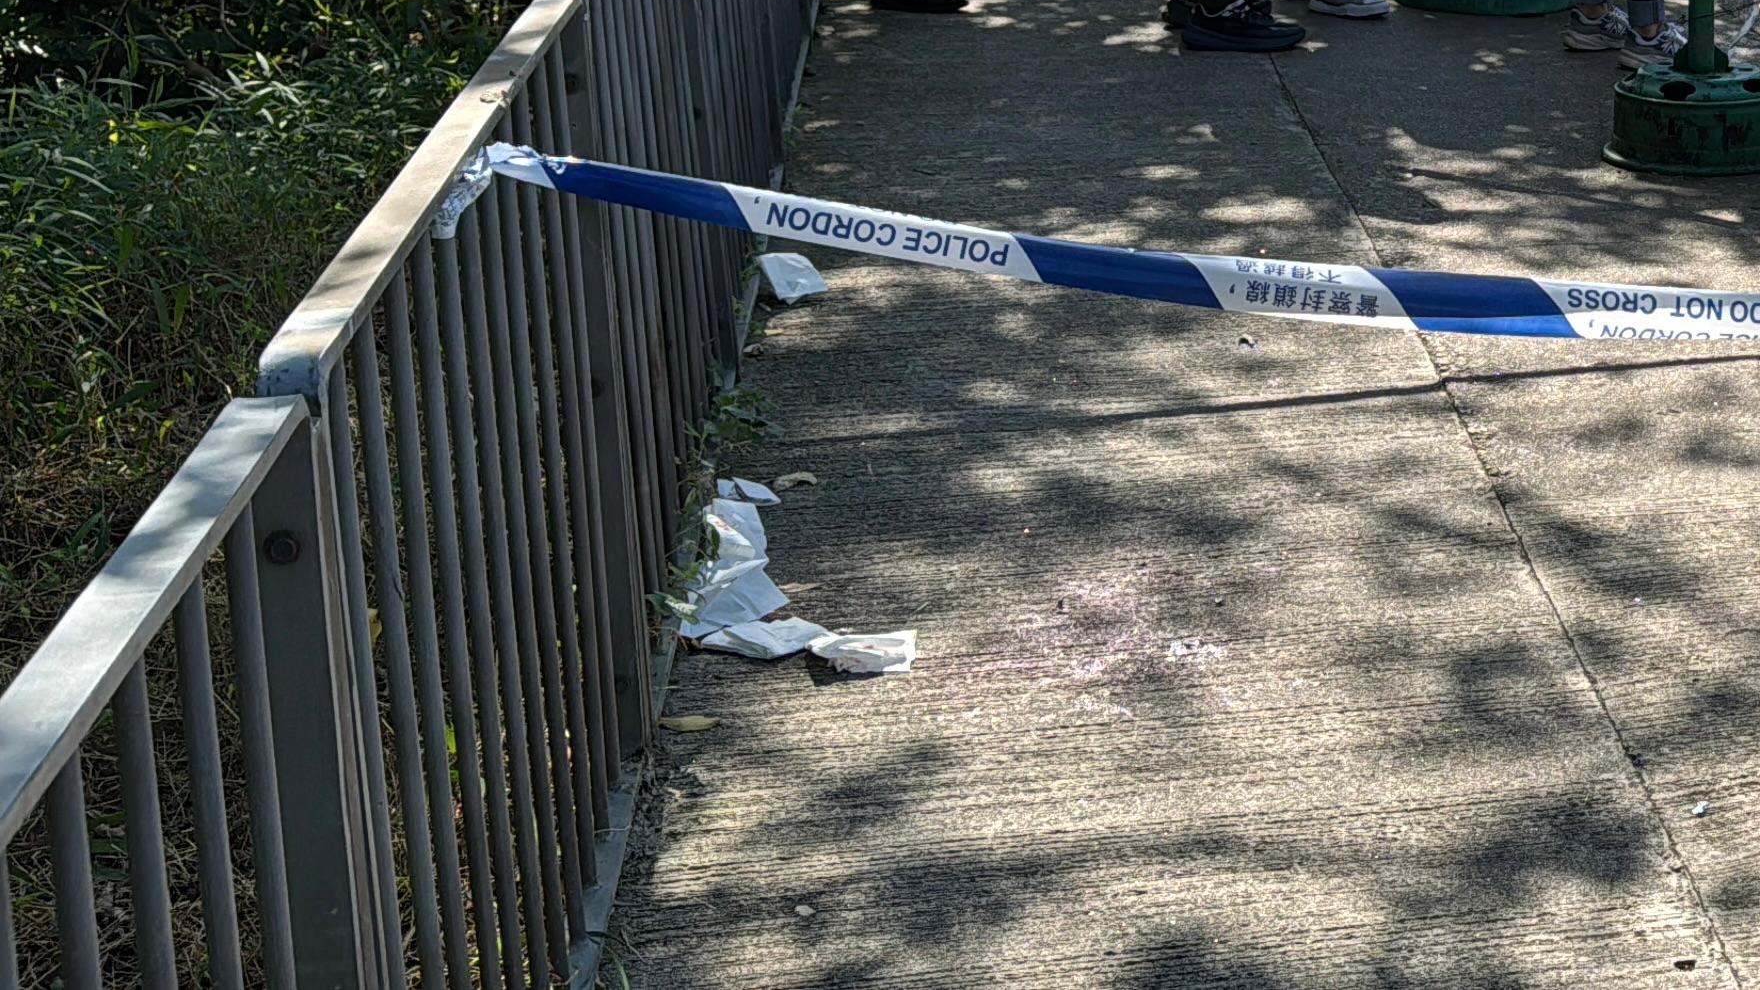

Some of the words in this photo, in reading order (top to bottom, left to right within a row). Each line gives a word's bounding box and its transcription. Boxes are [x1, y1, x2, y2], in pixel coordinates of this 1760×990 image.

[902, 227, 1010, 267] POLICE
[1235, 259, 1342, 285] 不得越過
[1567, 288, 1658, 315] CROSS
[1670, 296, 1723, 321] NOT
